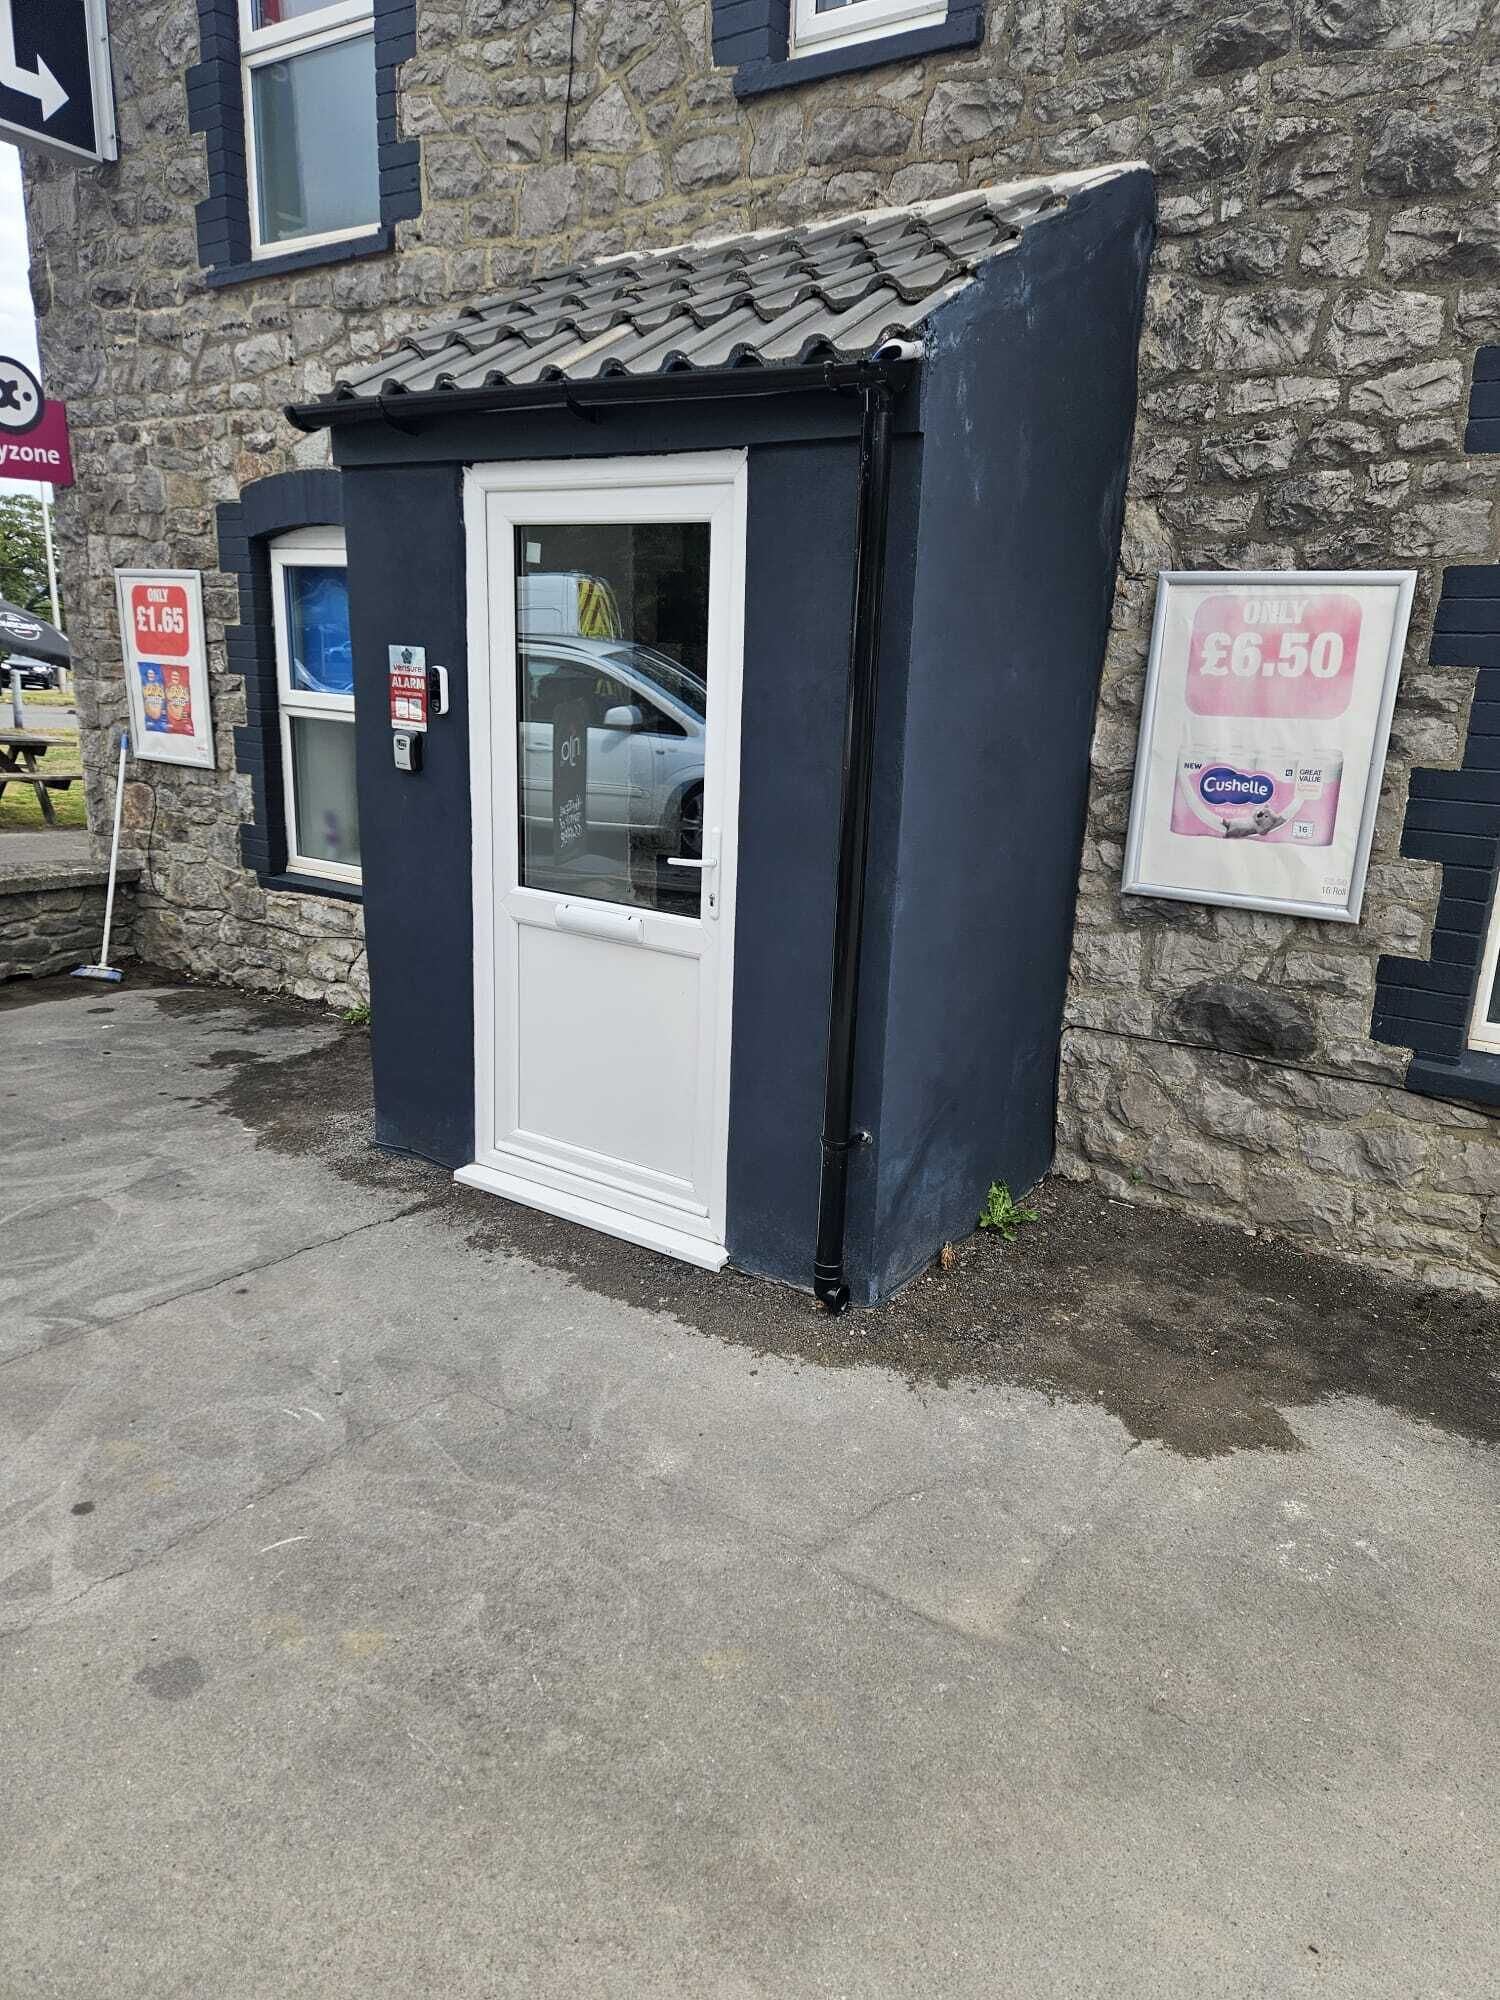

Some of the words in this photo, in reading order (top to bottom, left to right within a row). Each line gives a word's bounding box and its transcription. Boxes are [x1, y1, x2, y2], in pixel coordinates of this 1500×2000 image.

[147, 588, 169, 603] ONLY
[136, 605, 184, 634] £1.65
[1242, 600, 1307, 624] ONLY
[1200, 631, 1344, 678] £6.50
[391, 675, 425, 690] ALARM
[1184, 762, 1202, 770] NEW
[1203, 776, 1268, 796] Cushelle
[1299, 775, 1321, 783] VALUE
